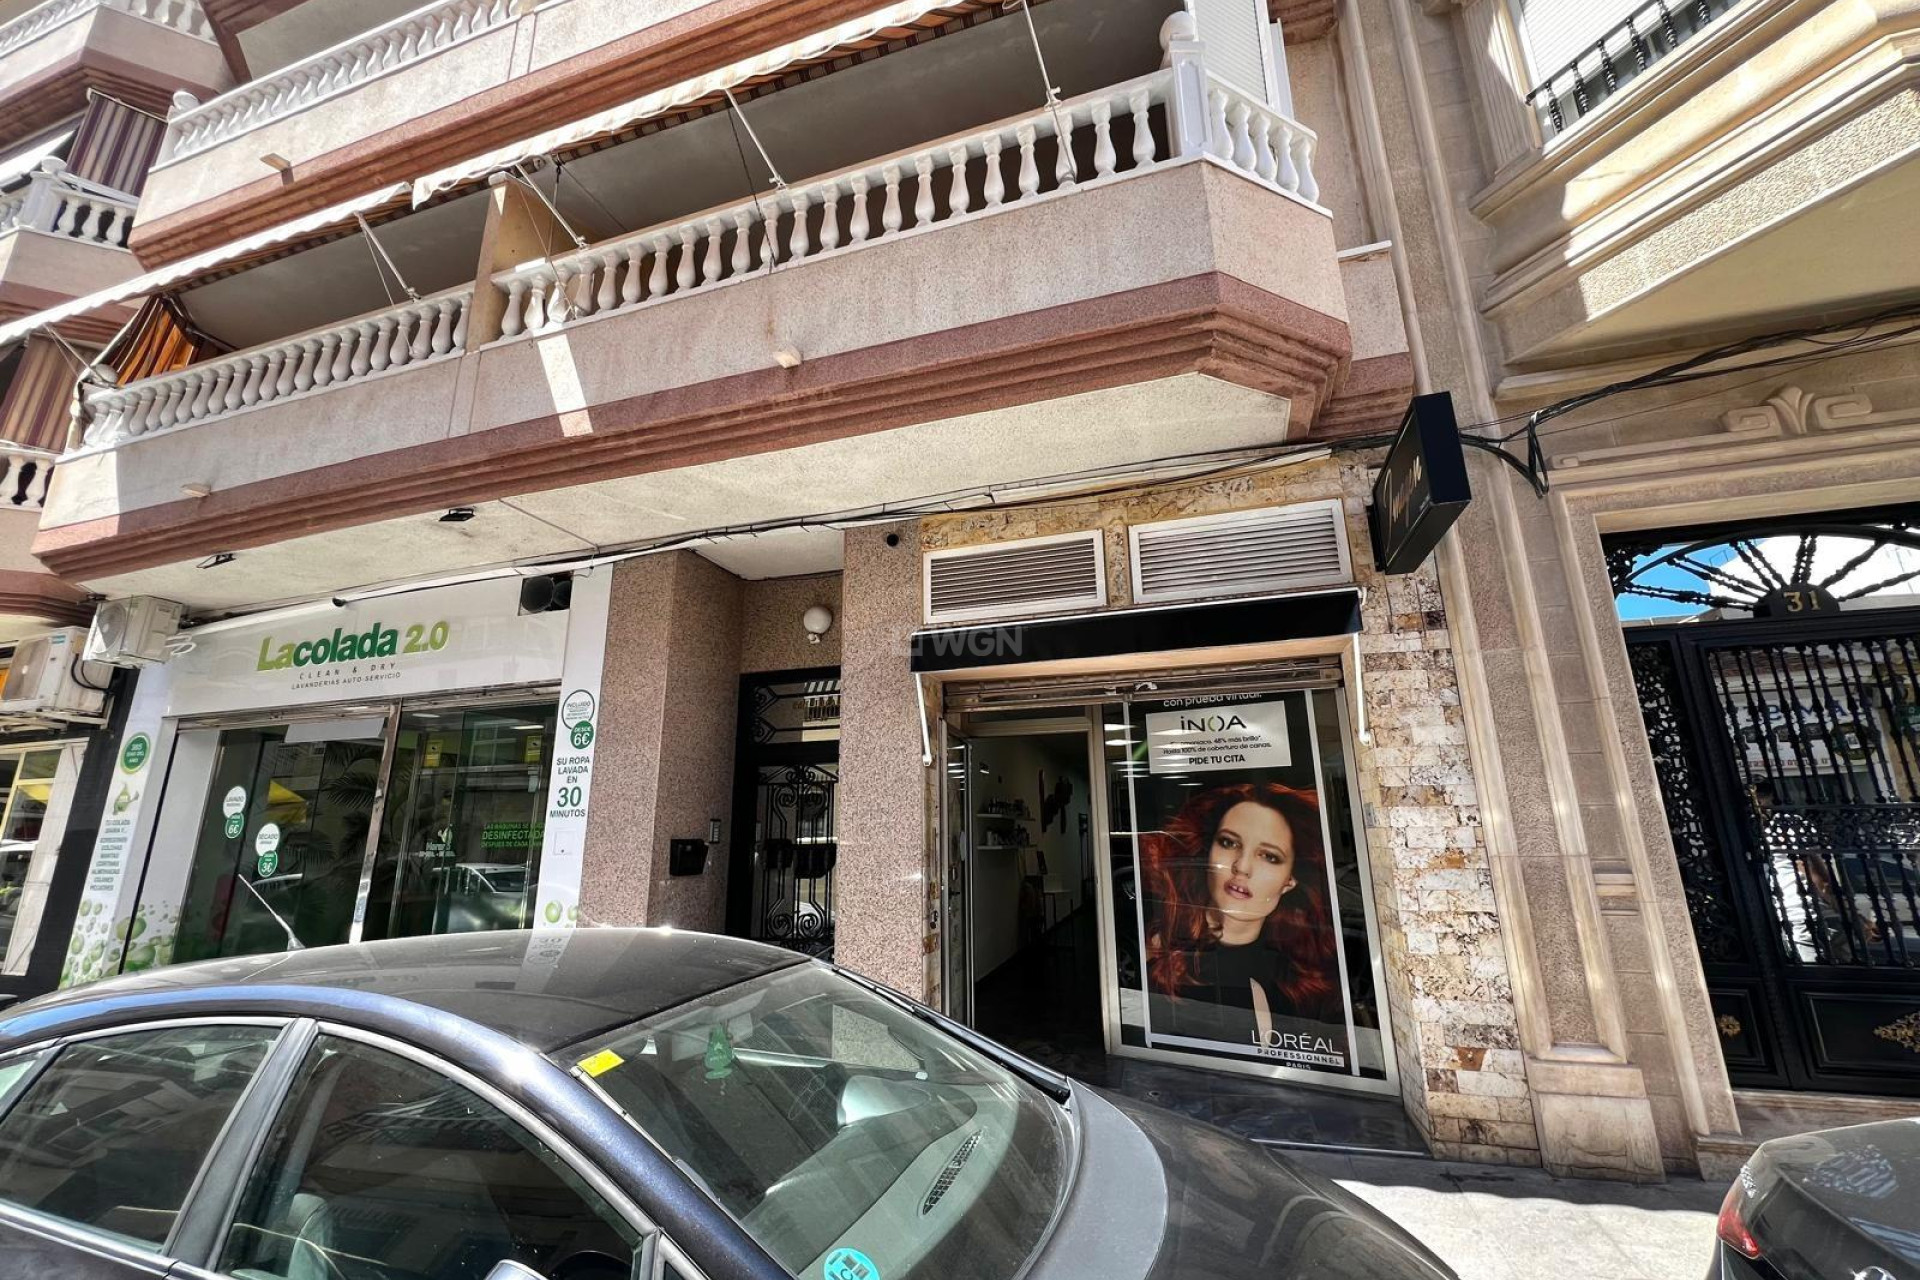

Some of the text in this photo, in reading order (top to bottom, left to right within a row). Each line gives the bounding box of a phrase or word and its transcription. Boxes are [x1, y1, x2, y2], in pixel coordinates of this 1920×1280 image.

[1783, 590, 1821, 611] 31
[257, 620, 450, 671] Lacolada 2.0
[299, 669, 340, 681] CLEAN
[370, 662, 397, 673] DRY
[291, 671, 401, 690] LAVANDERIAS AUTO SERVICIO
[1163, 699, 1183, 707] con
[574, 732, 590, 746] 6€
[556, 756, 590, 766] SU ROPA
[1188, 754, 1246, 765] PIDE TU CITA
[557, 766, 589, 775] LAVADA
[567, 775, 578, 783] EN
[557, 786, 582, 808] 30
[550, 808, 586, 818] MINUTOS
[1257, 1047, 1341, 1065] PROFESSIONNEL
[1286, 1061, 1311, 1070] PARIS
